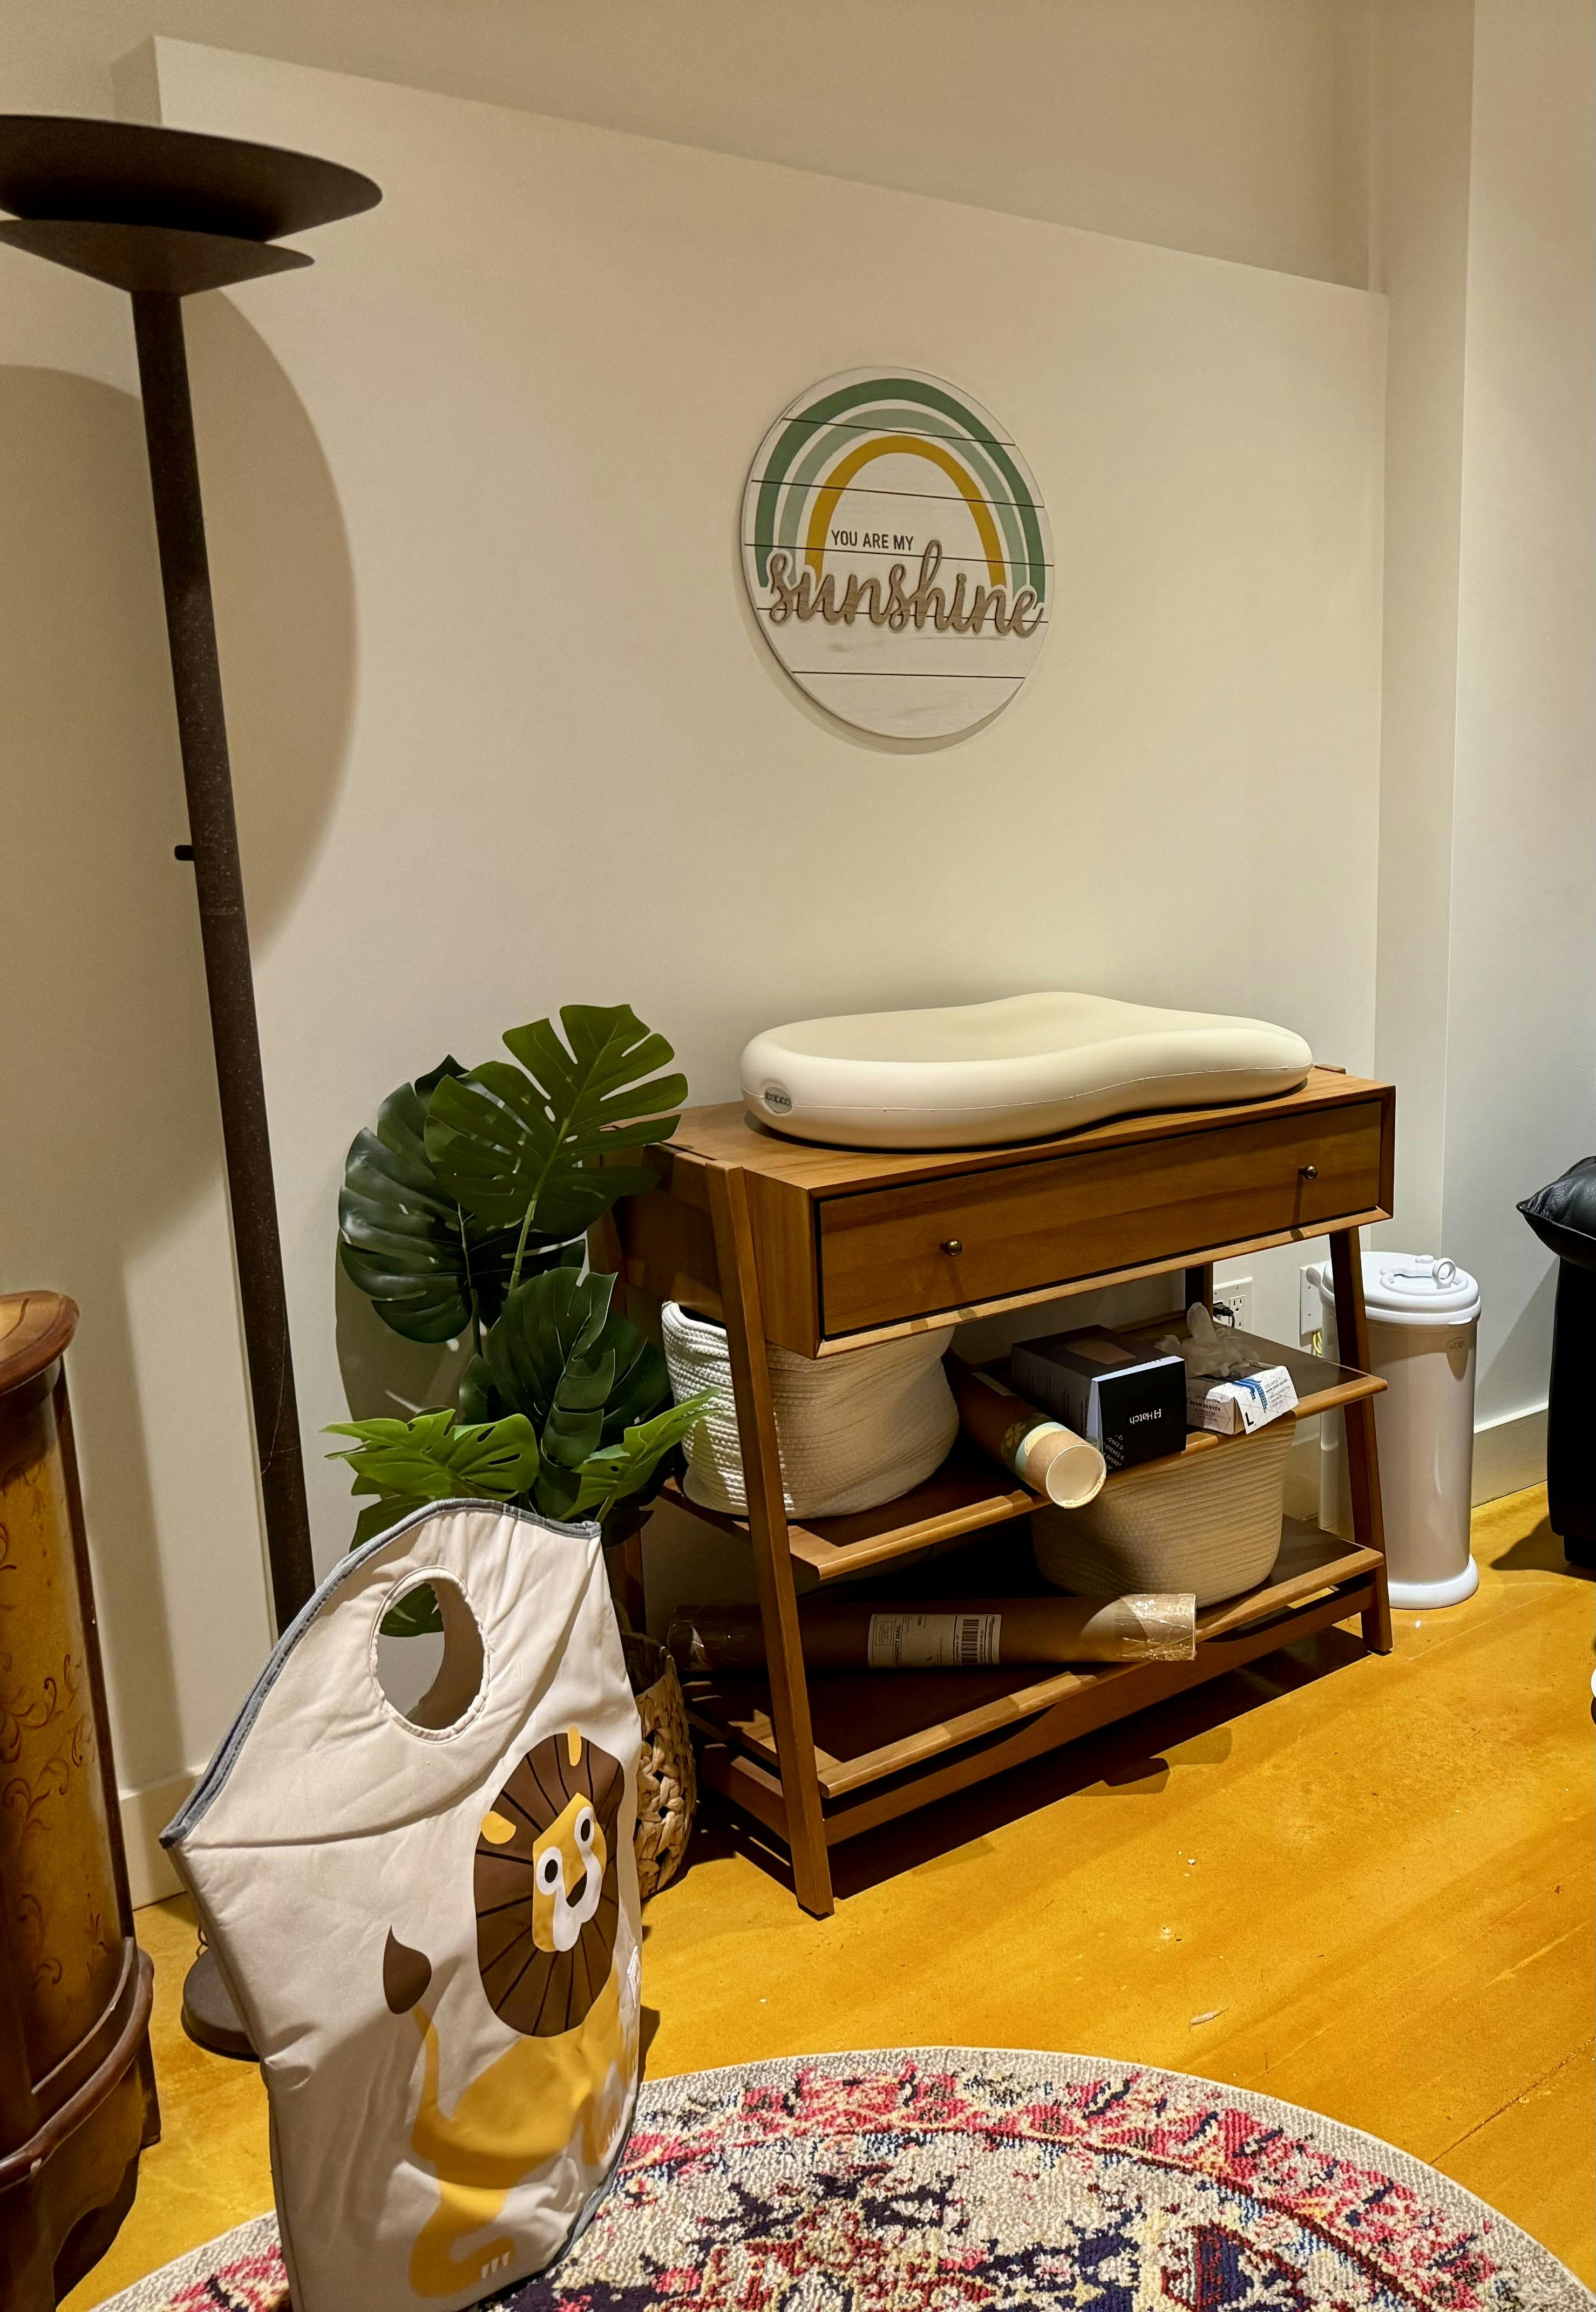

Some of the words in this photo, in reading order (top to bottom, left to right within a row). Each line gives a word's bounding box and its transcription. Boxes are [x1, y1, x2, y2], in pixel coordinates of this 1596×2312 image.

[831, 529, 857, 546] YOU
[862, 532, 889, 549] ARE
[893, 534, 914, 551] MY
[770, 540, 1043, 637] sunshine
[1129, 1411, 1153, 1425] Hatch
[1245, 1412, 1254, 1426] L
